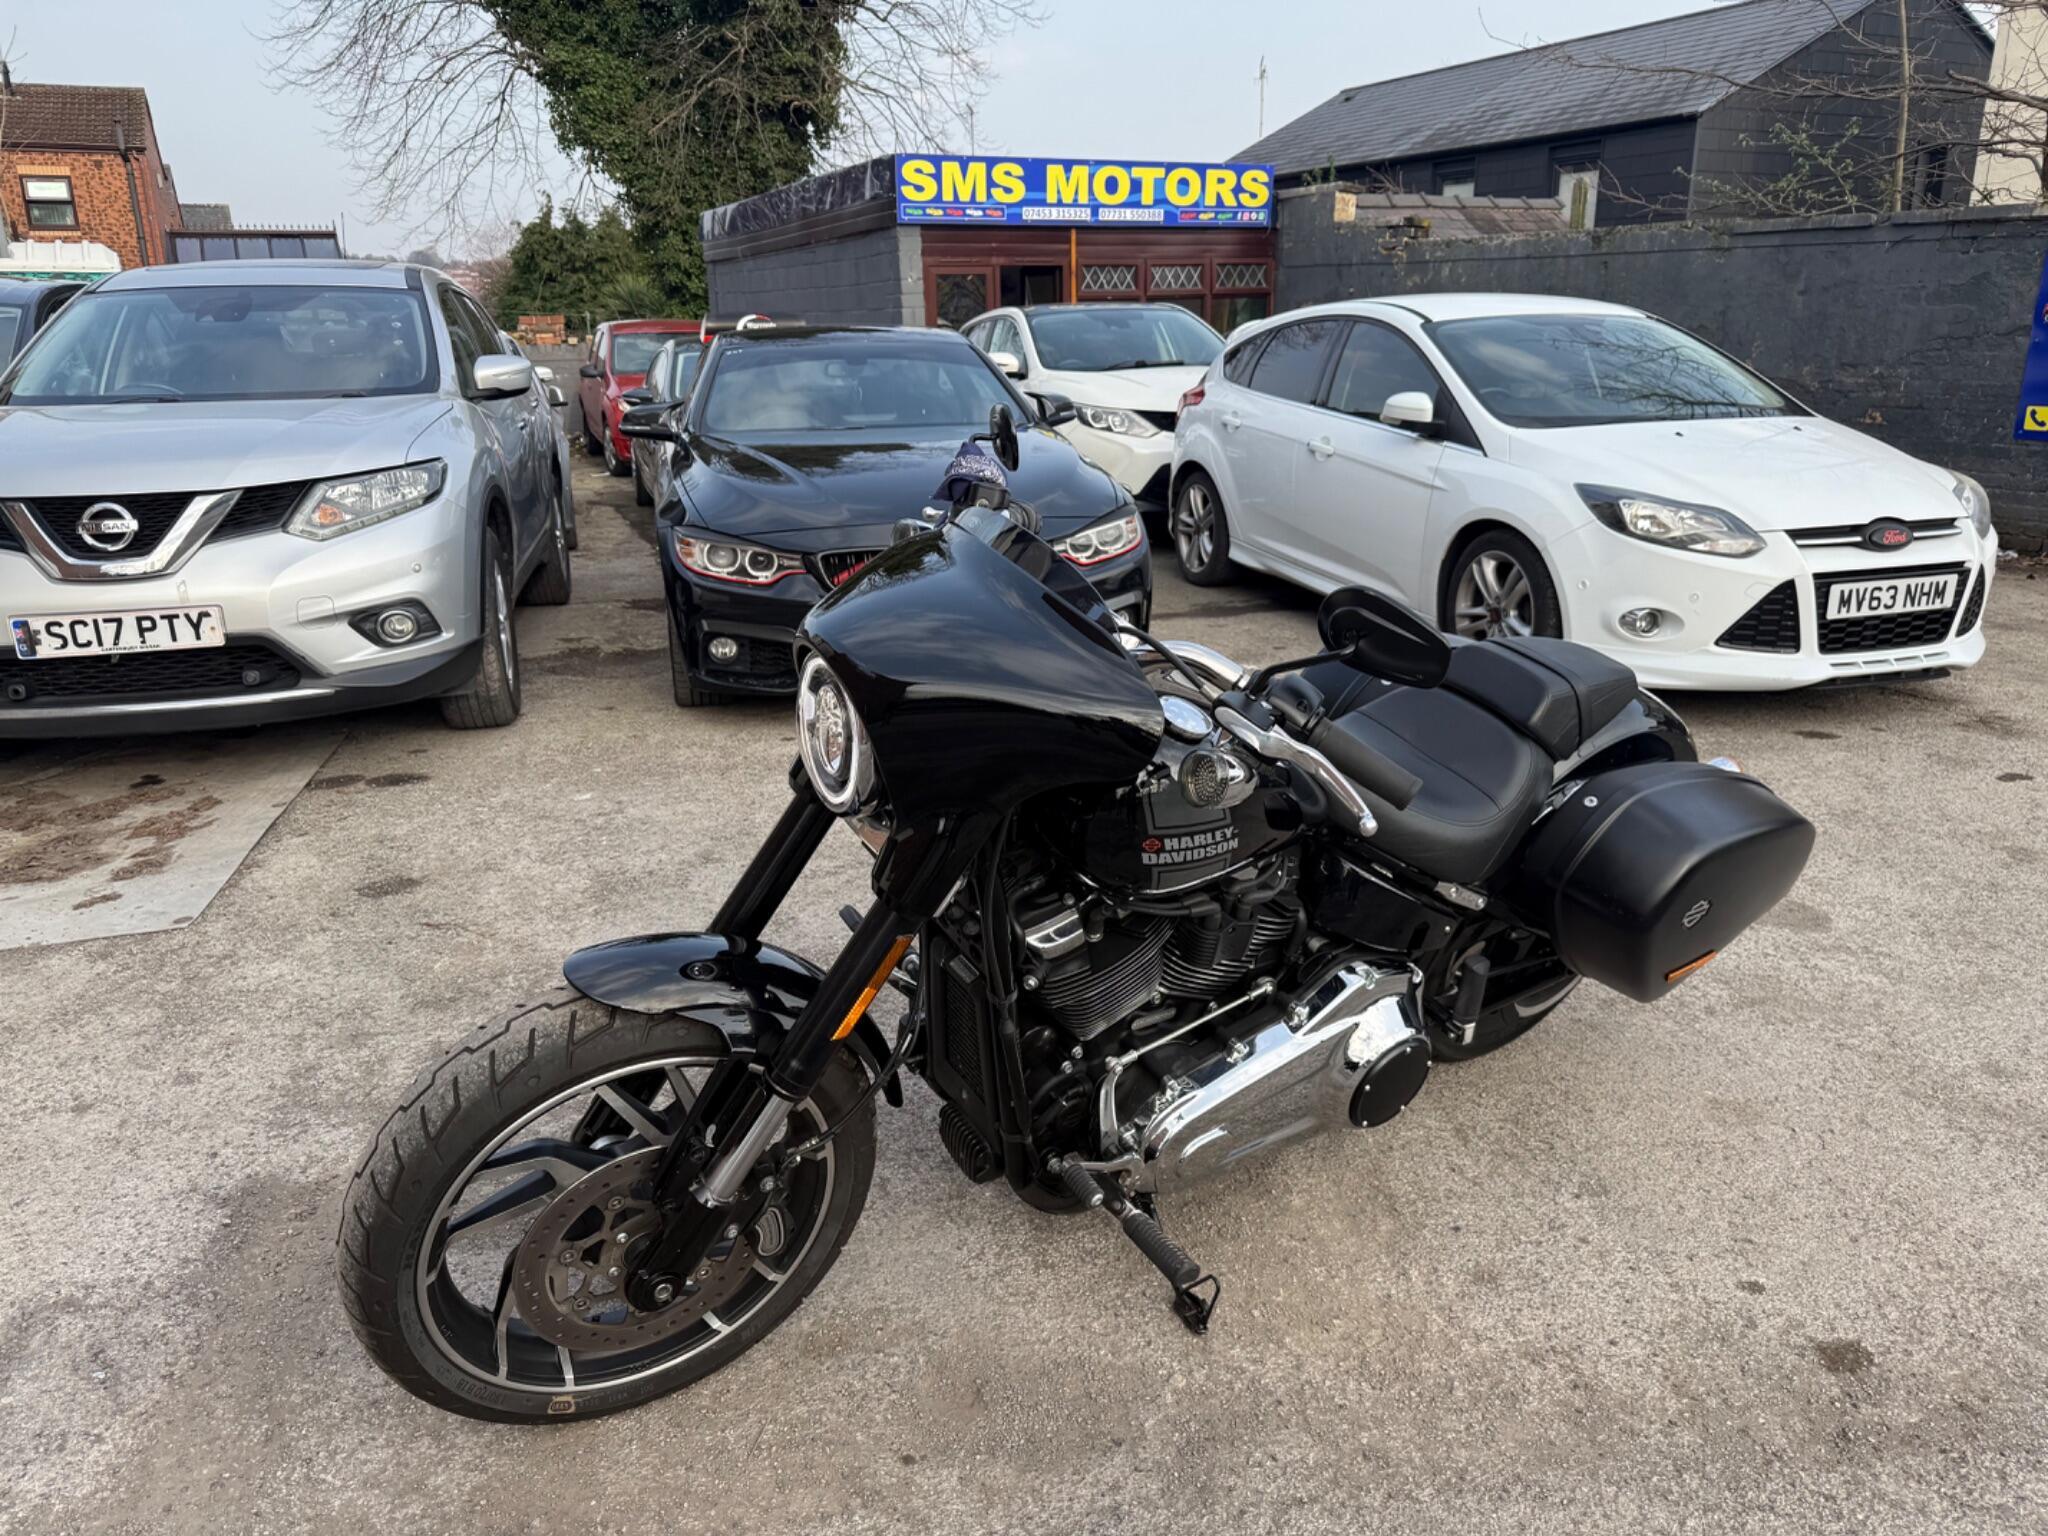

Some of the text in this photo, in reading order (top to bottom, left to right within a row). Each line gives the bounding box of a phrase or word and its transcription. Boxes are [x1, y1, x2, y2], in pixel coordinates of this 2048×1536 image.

[901, 159, 1270, 207] SMS MOTORS
[81, 521, 130, 533] NISSAN
[1882, 529, 1907, 545] Ford
[1837, 580, 1949, 614] MV63 NHM
[44, 610, 212, 650] SC17 PTY
[1141, 837, 1239, 865] DAVIDSON
[1163, 826, 1240, 851] HARLEY-
